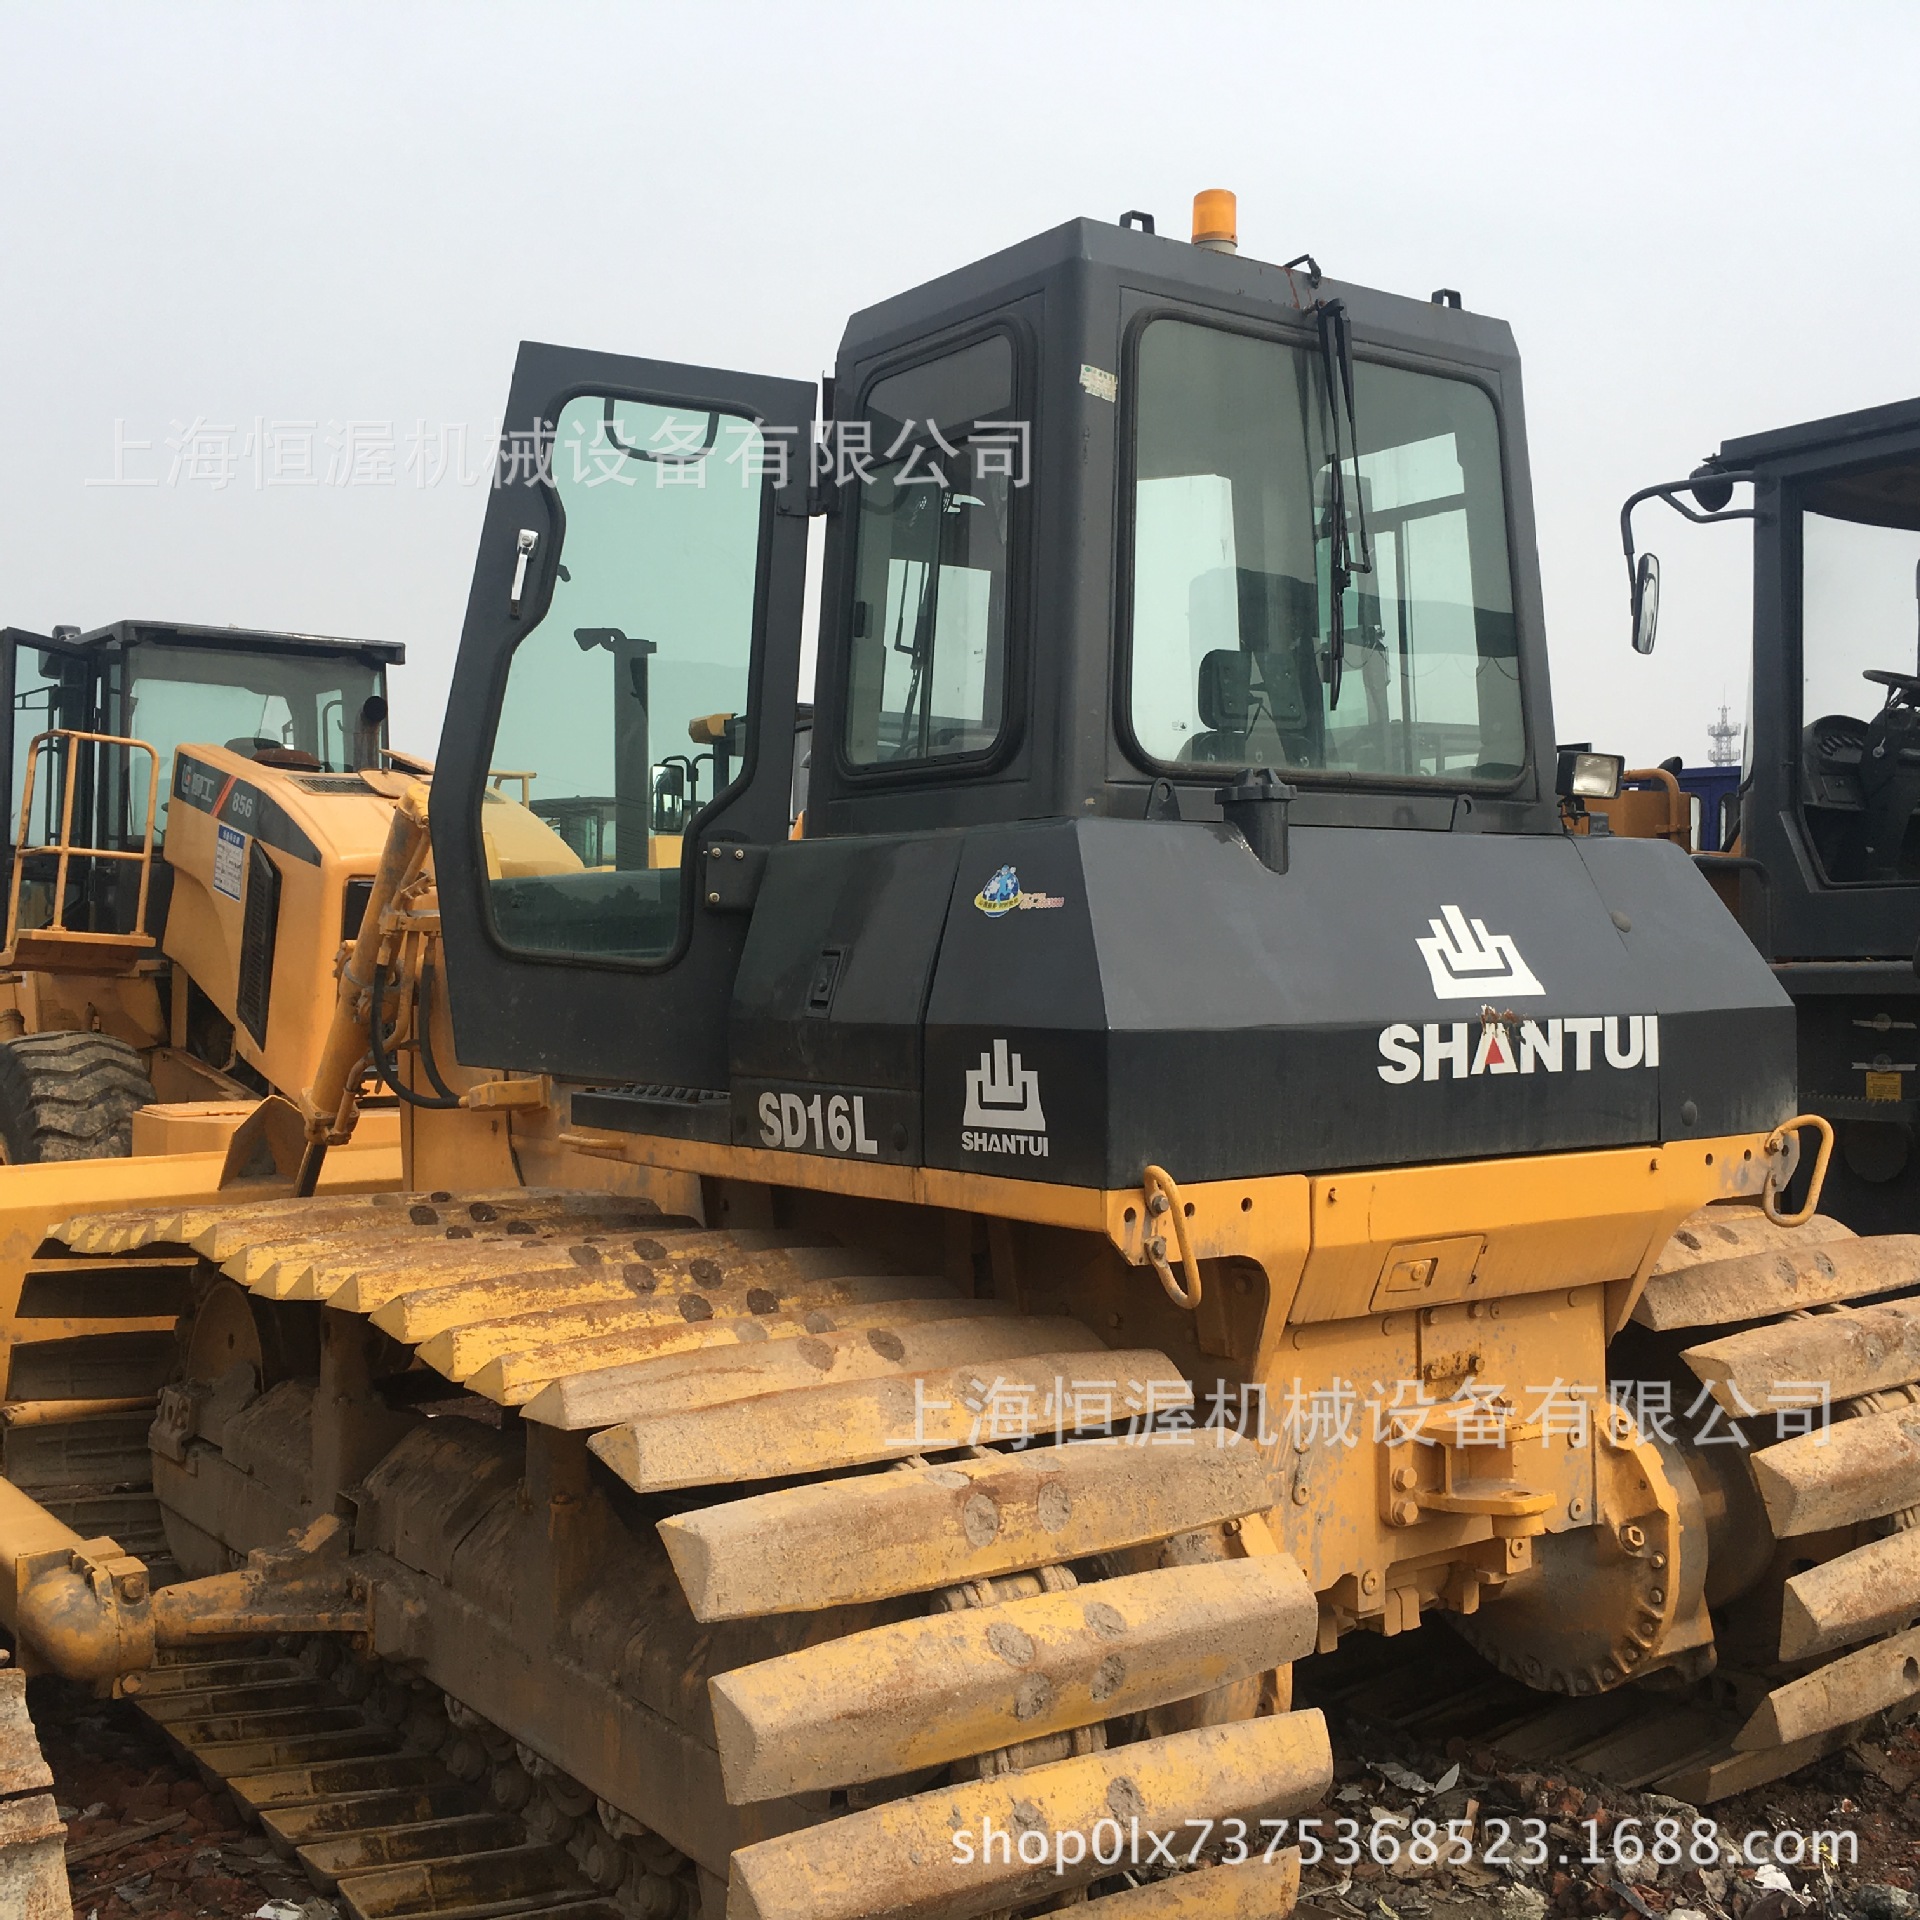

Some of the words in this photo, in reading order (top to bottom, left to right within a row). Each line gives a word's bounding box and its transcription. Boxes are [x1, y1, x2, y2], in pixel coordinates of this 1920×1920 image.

[231, 792, 253, 818] 856
[1377, 1015, 1659, 1084] SHANTUI
[758, 1091, 878, 1155] SD16L
[961, 1131, 1049, 1157] SHANTUI
